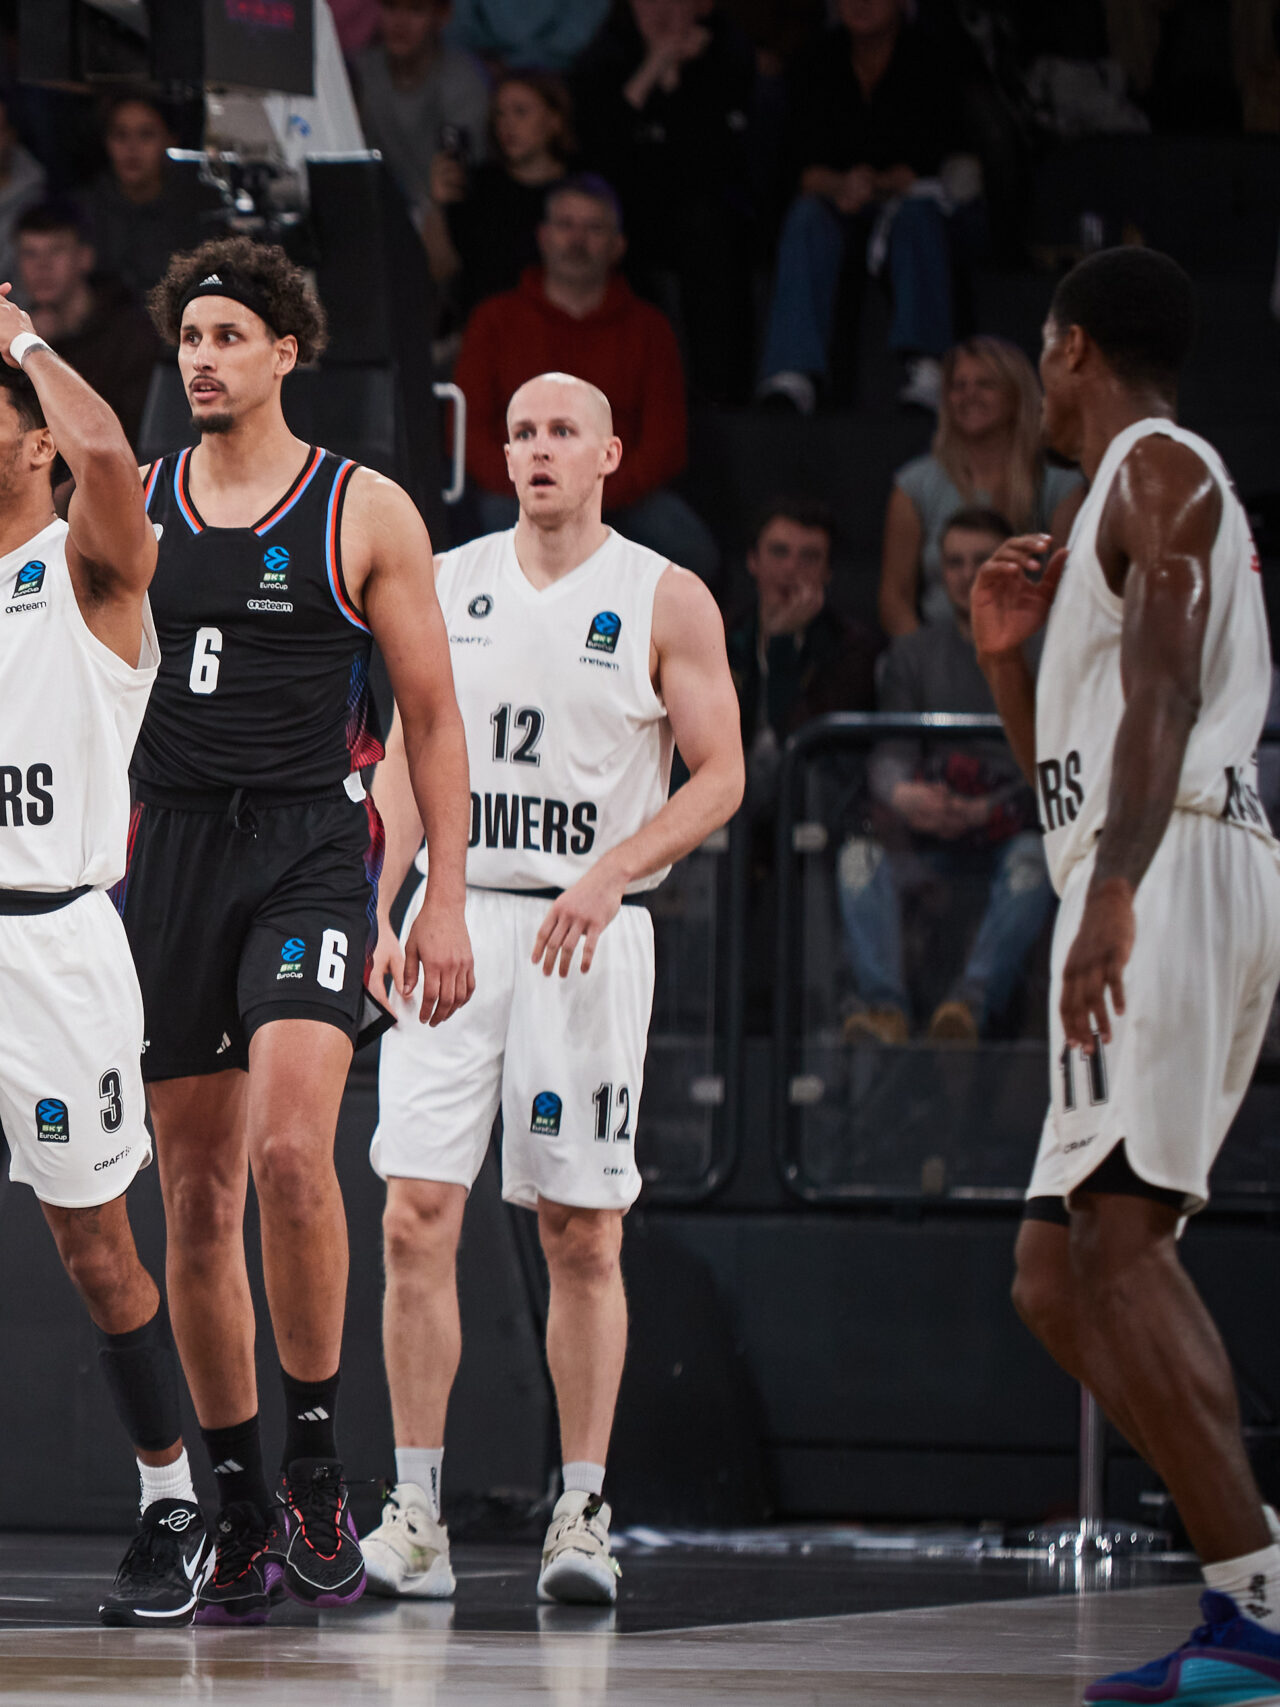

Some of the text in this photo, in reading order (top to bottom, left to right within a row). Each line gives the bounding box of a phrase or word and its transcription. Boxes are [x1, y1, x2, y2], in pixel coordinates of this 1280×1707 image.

[263, 573, 286, 581] BKT
[260, 582, 288, 590] EuroCup
[5, 601, 47, 614] oneteam
[247, 600, 293, 612] oneteam
[189, 627, 223, 694] 6
[490, 702, 545, 767] 12
[468, 791, 597, 856] OWERS
[317, 928, 348, 992] 6
[276, 972, 303, 980] EuroCup
[99, 1067, 124, 1134] 3
[592, 1082, 631, 1143] 12
[41, 1125, 63, 1133] BKT
[39, 1132, 67, 1141] EuroCup
[94, 1150, 125, 1171] CRAFT
[603, 1167, 628, 1175] CRA
